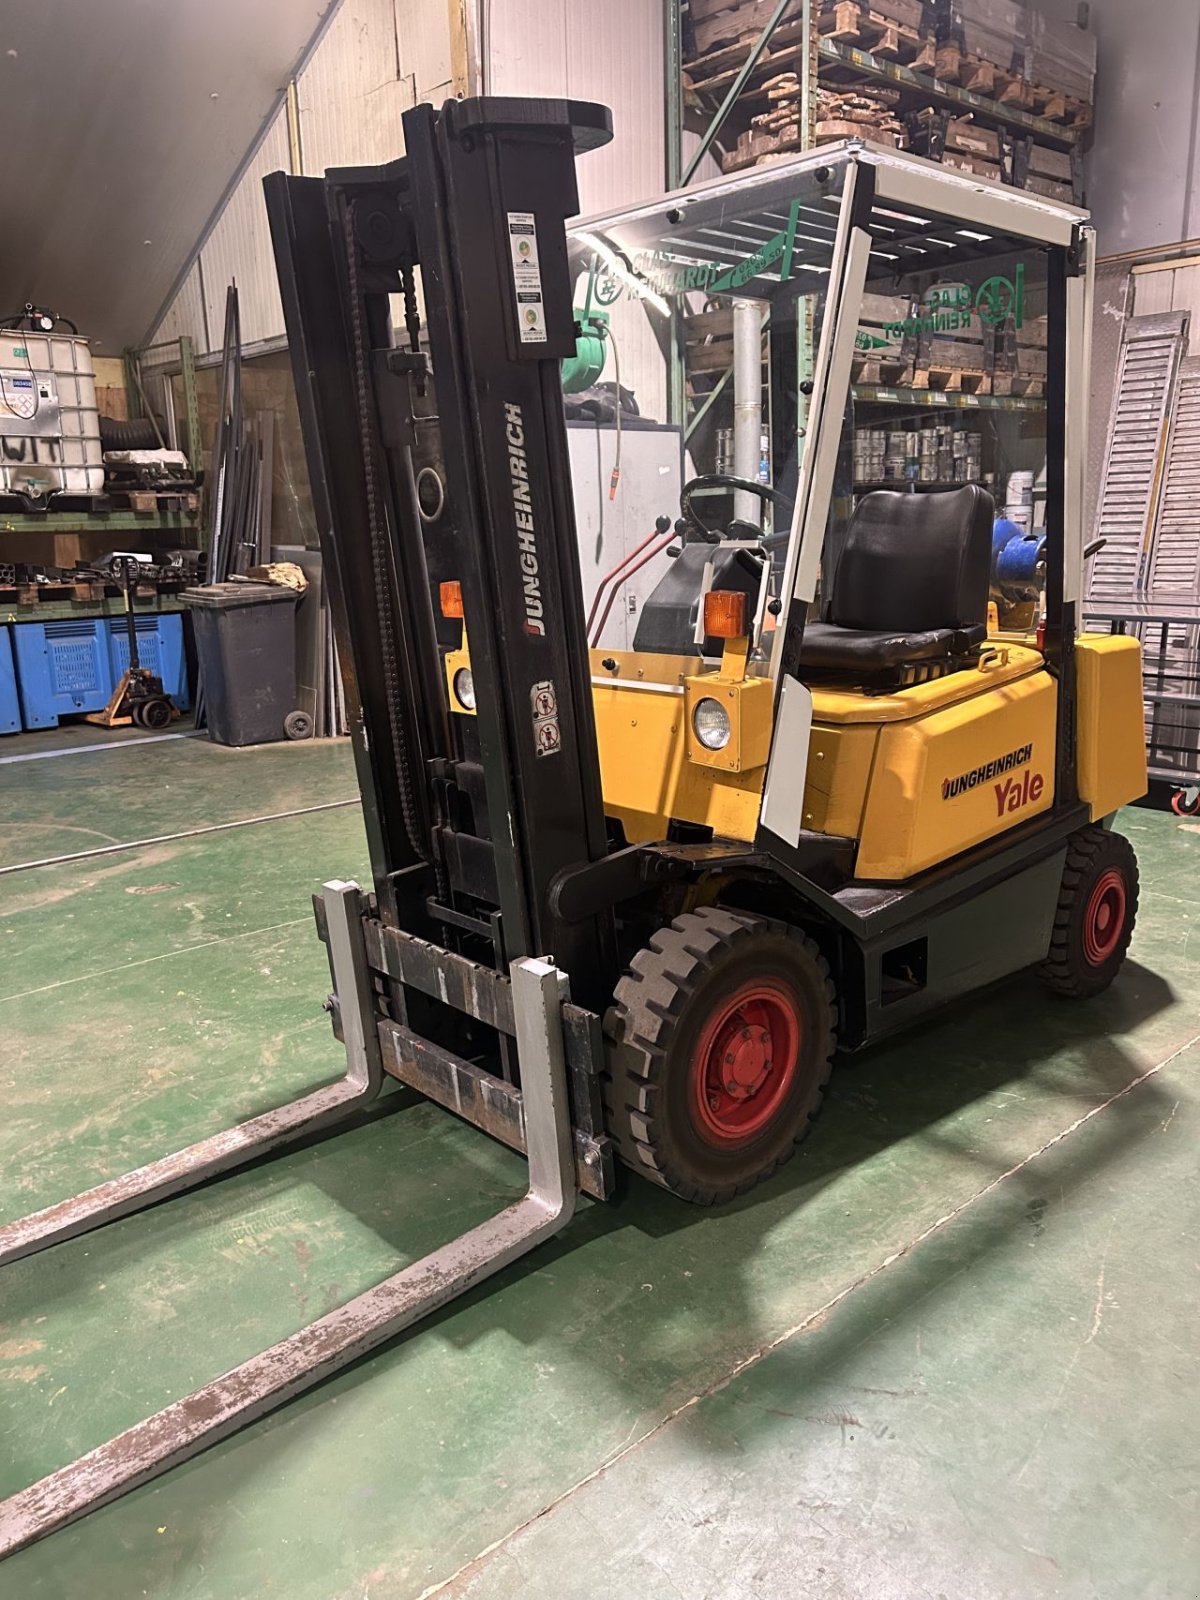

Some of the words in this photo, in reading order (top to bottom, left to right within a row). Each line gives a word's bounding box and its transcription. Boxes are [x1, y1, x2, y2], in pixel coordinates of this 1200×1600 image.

[504, 402, 546, 637] JUNGHEINRICH
[941, 743, 1033, 800] JUNGHEINRICH
[994, 769, 1044, 817] Yale
